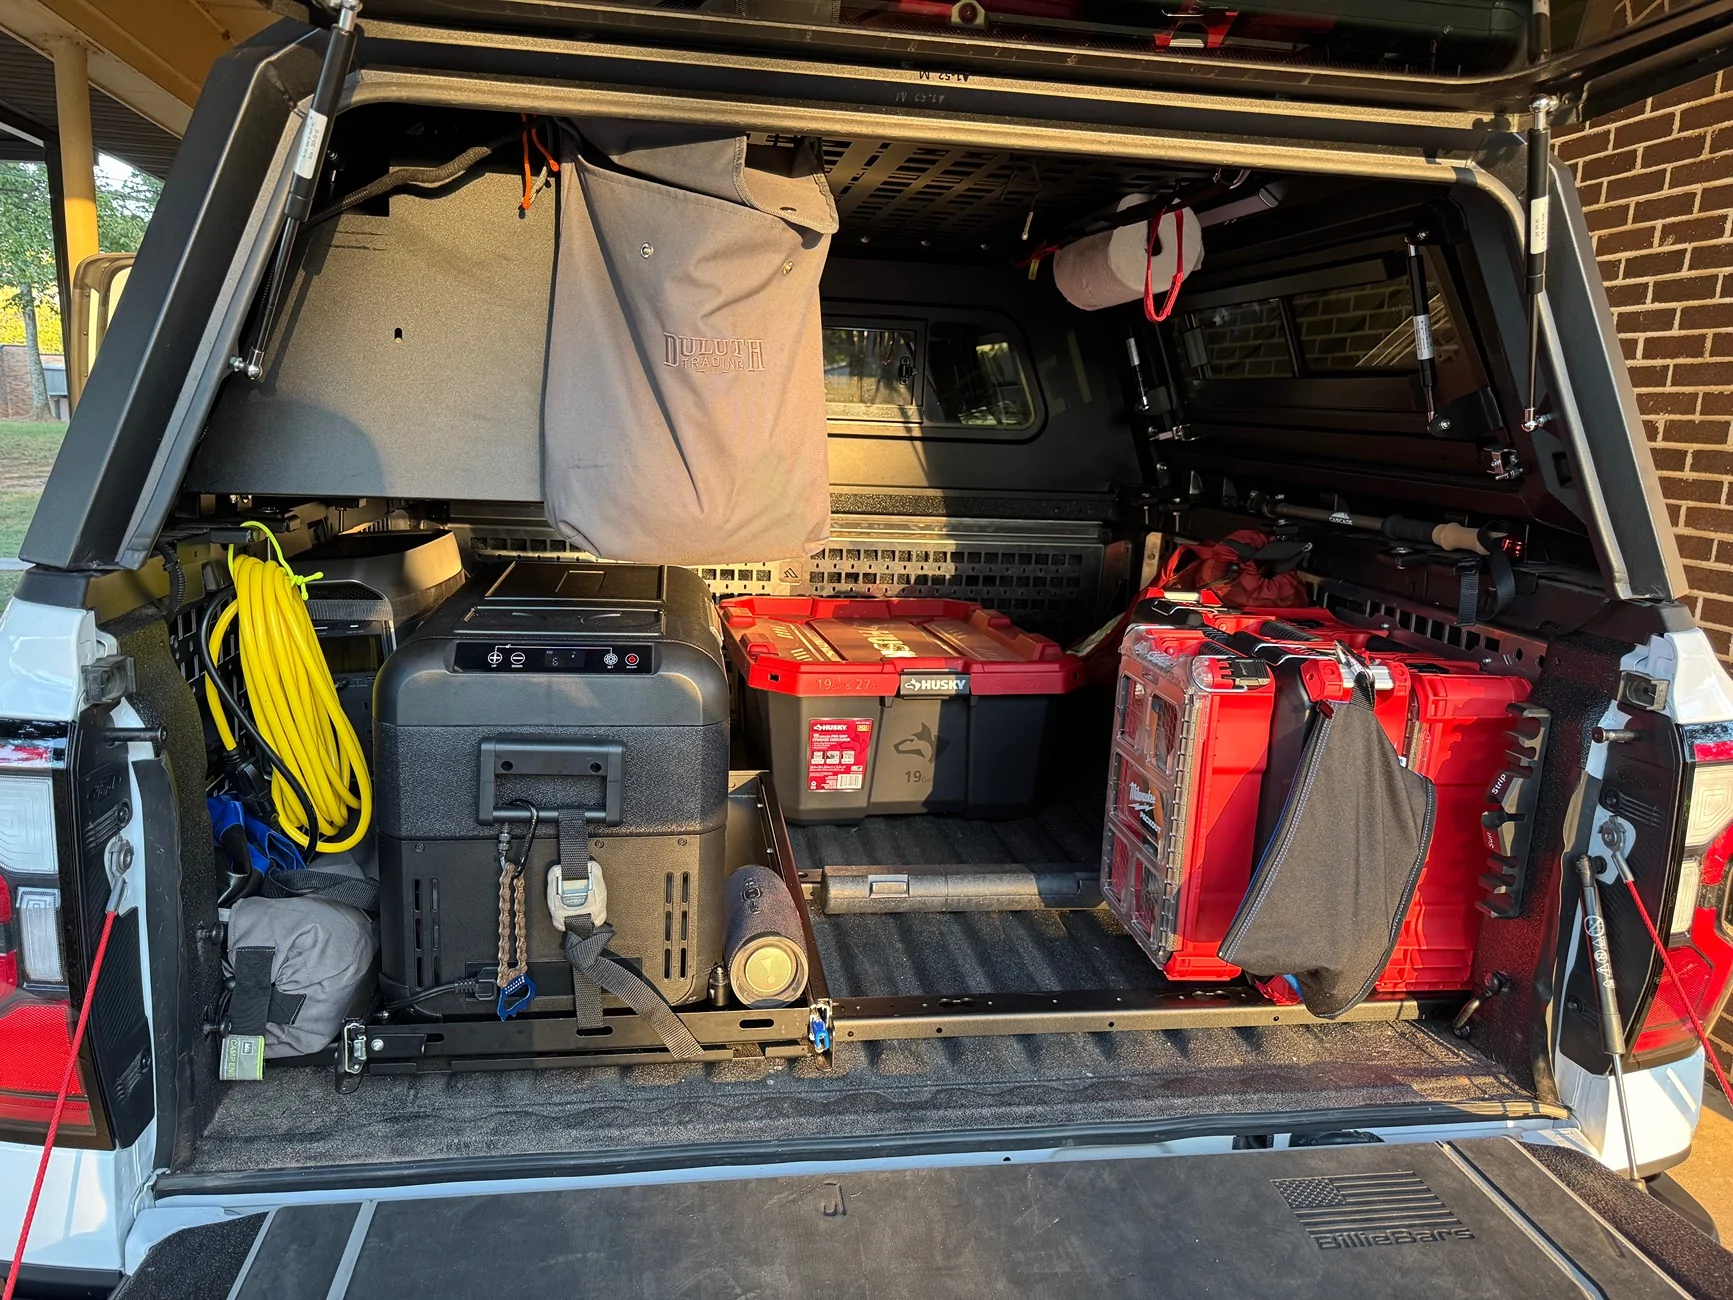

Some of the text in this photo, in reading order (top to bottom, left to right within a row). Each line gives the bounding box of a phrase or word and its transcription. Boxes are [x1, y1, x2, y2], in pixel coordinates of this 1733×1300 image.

[663, 332, 765, 372] DULUTH
[681, 356, 745, 371] TRADING
[922, 679, 966, 690] HUSKY
[1129, 781, 1156, 804] Milwaukee
[1491, 773, 1507, 795] Strip
[227, 1039, 238, 1078] CAMP END
[1311, 1228, 1476, 1250] BillieBars
